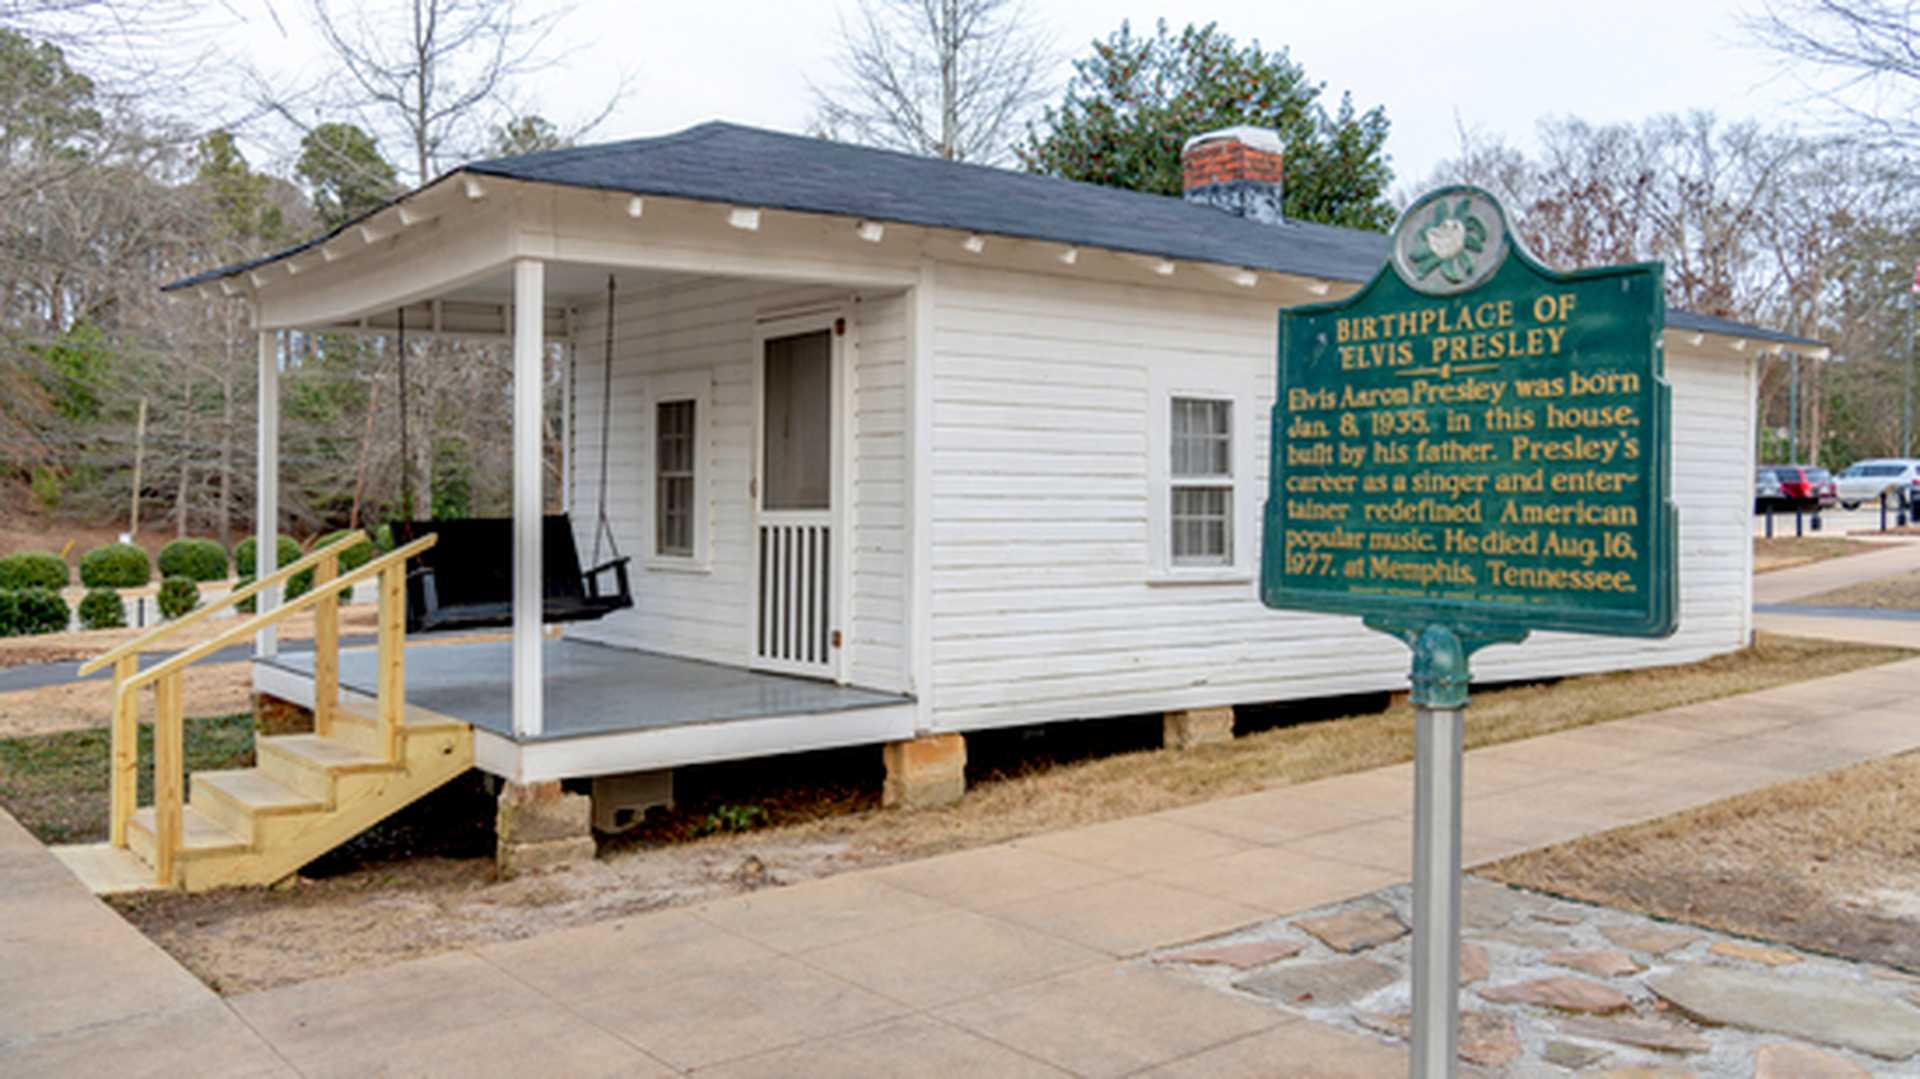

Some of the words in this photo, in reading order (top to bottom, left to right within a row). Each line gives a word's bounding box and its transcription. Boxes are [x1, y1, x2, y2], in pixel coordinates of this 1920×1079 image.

[1336, 302, 1513, 343] BIRTHPLACE
[1533, 295, 1576, 323] OF
[1340, 343, 1413, 369] ELVIS
[1432, 328, 1566, 362] PRESLEY
[1288, 388, 1335, 411] Elvis
[1340, 386, 1409, 408] Aaron
[1412, 380, 1506, 404] Presley
[1515, 380, 1564, 397] was
[1570, 371, 1640, 395] born
[1447, 408, 1471, 433] in
[1485, 407, 1534, 429] this
[1288, 445, 1332, 466] built
[1340, 444, 1366, 467] by
[1374, 443, 1407, 464] his
[1417, 439, 1498, 462] father.
[1512, 431, 1639, 460] Presley's
[1286, 475, 1356, 492] career
[1363, 475, 1387, 492] as
[1392, 475, 1406, 492] a
[1412, 470, 1488, 499] singer
[1495, 470, 1543, 492] and
[1287, 501, 1350, 521] tainer
[1364, 500, 1481, 522] redefined
[1500, 501, 1637, 525] American
[1285, 528, 1364, 553] popular
[1444, 529, 1478, 552] He
[1481, 531, 1537, 556] died
[1344, 557, 1364, 578] at
[1488, 560, 1636, 592] Tennessee.
